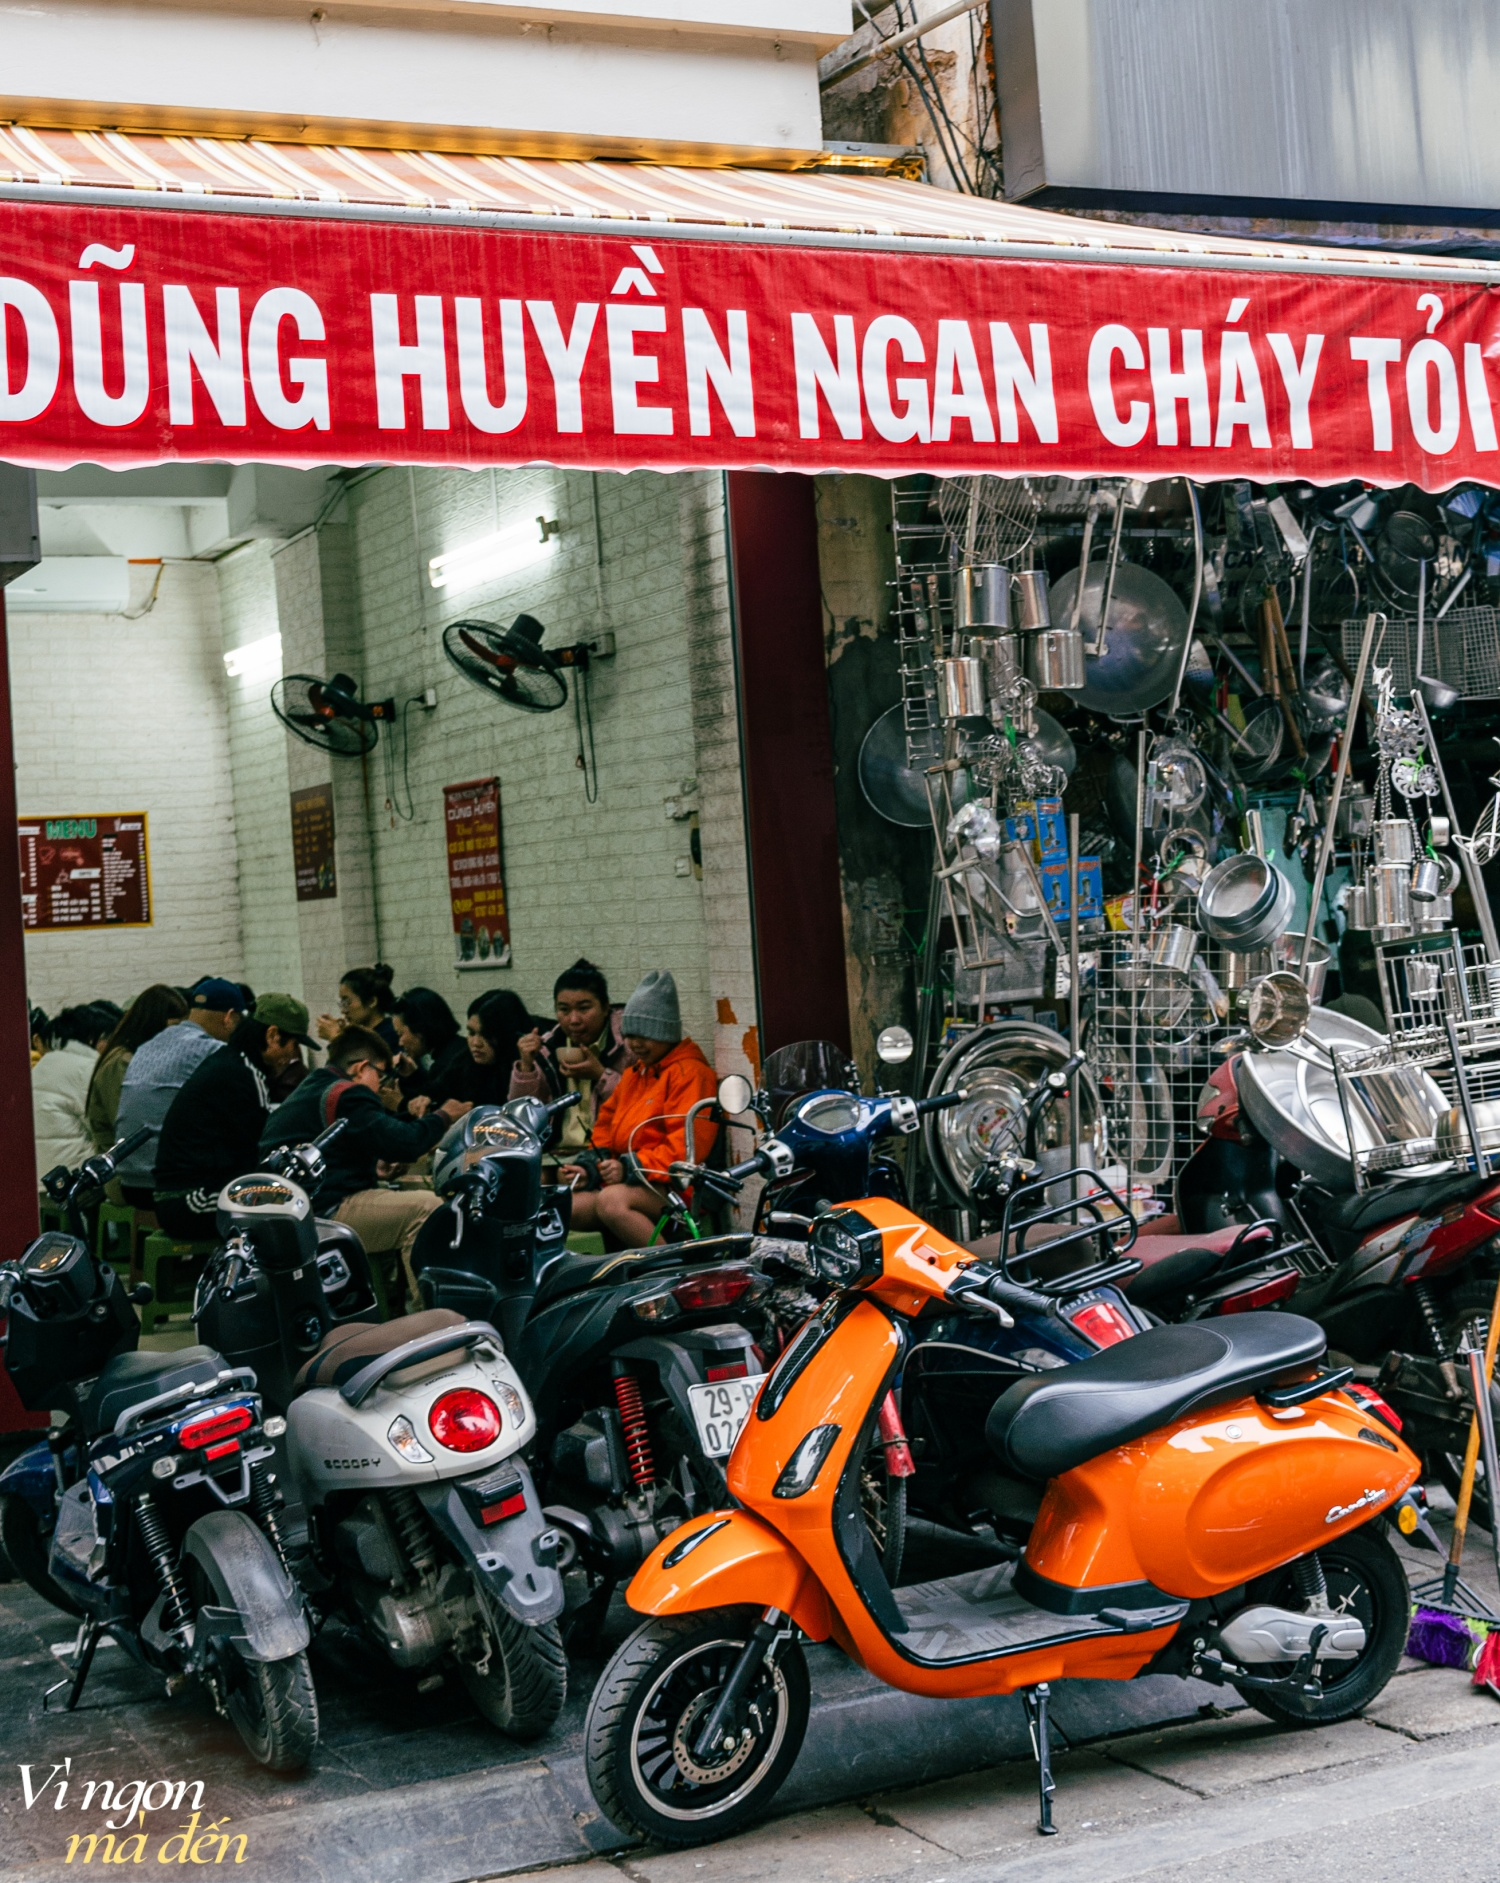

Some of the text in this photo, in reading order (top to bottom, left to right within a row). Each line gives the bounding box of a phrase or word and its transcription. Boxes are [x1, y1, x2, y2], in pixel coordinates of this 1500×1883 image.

[0, 243, 1499, 455] DŨNG HUYỀN NGAN CHÁY TỎI
[46, 819, 97, 839] MENU
[705, 1418, 745, 1451] 02
[323, 1457, 381, 1469] SCOOPY
